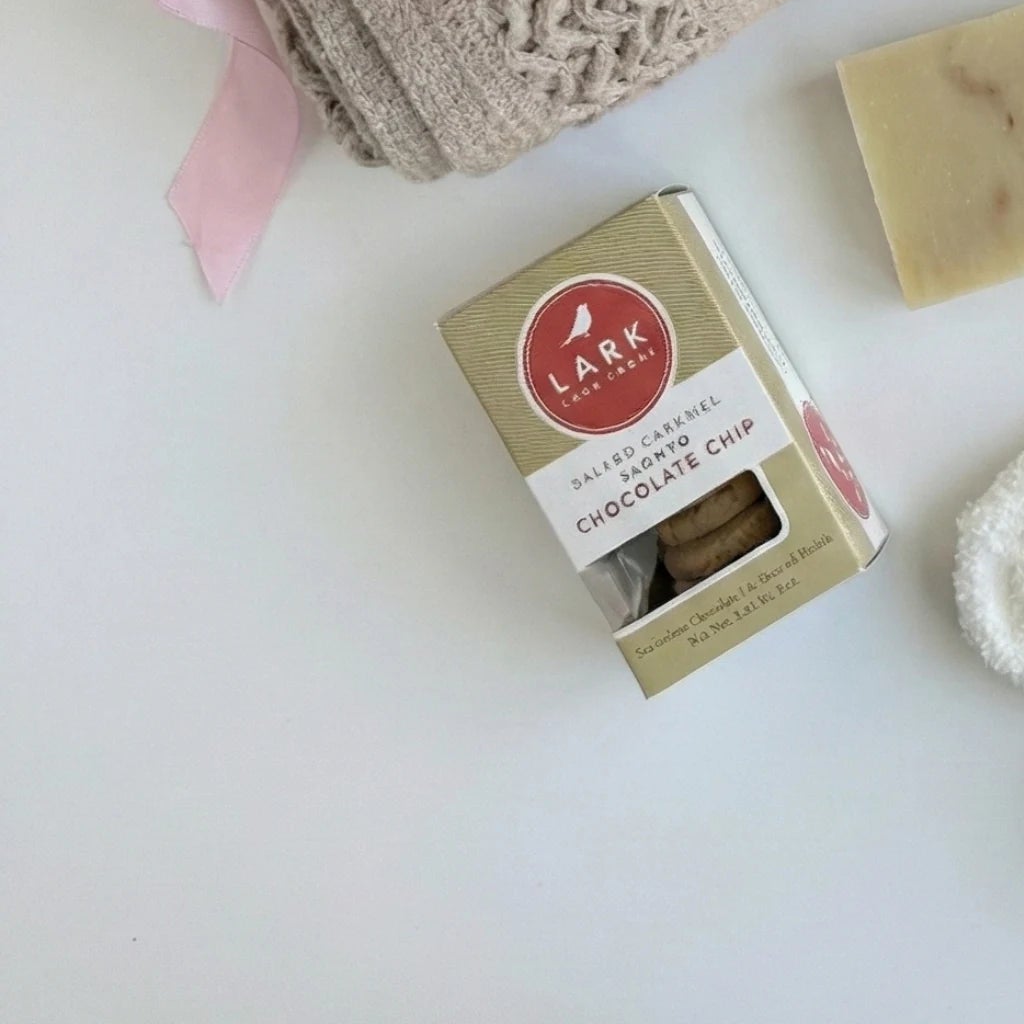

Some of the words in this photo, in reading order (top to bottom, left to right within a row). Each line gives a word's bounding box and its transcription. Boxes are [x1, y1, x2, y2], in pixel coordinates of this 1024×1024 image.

[547, 320, 649, 394] LARK
[576, 452, 701, 534] CHOCOLATE
[705, 417, 755, 456] CHIP
